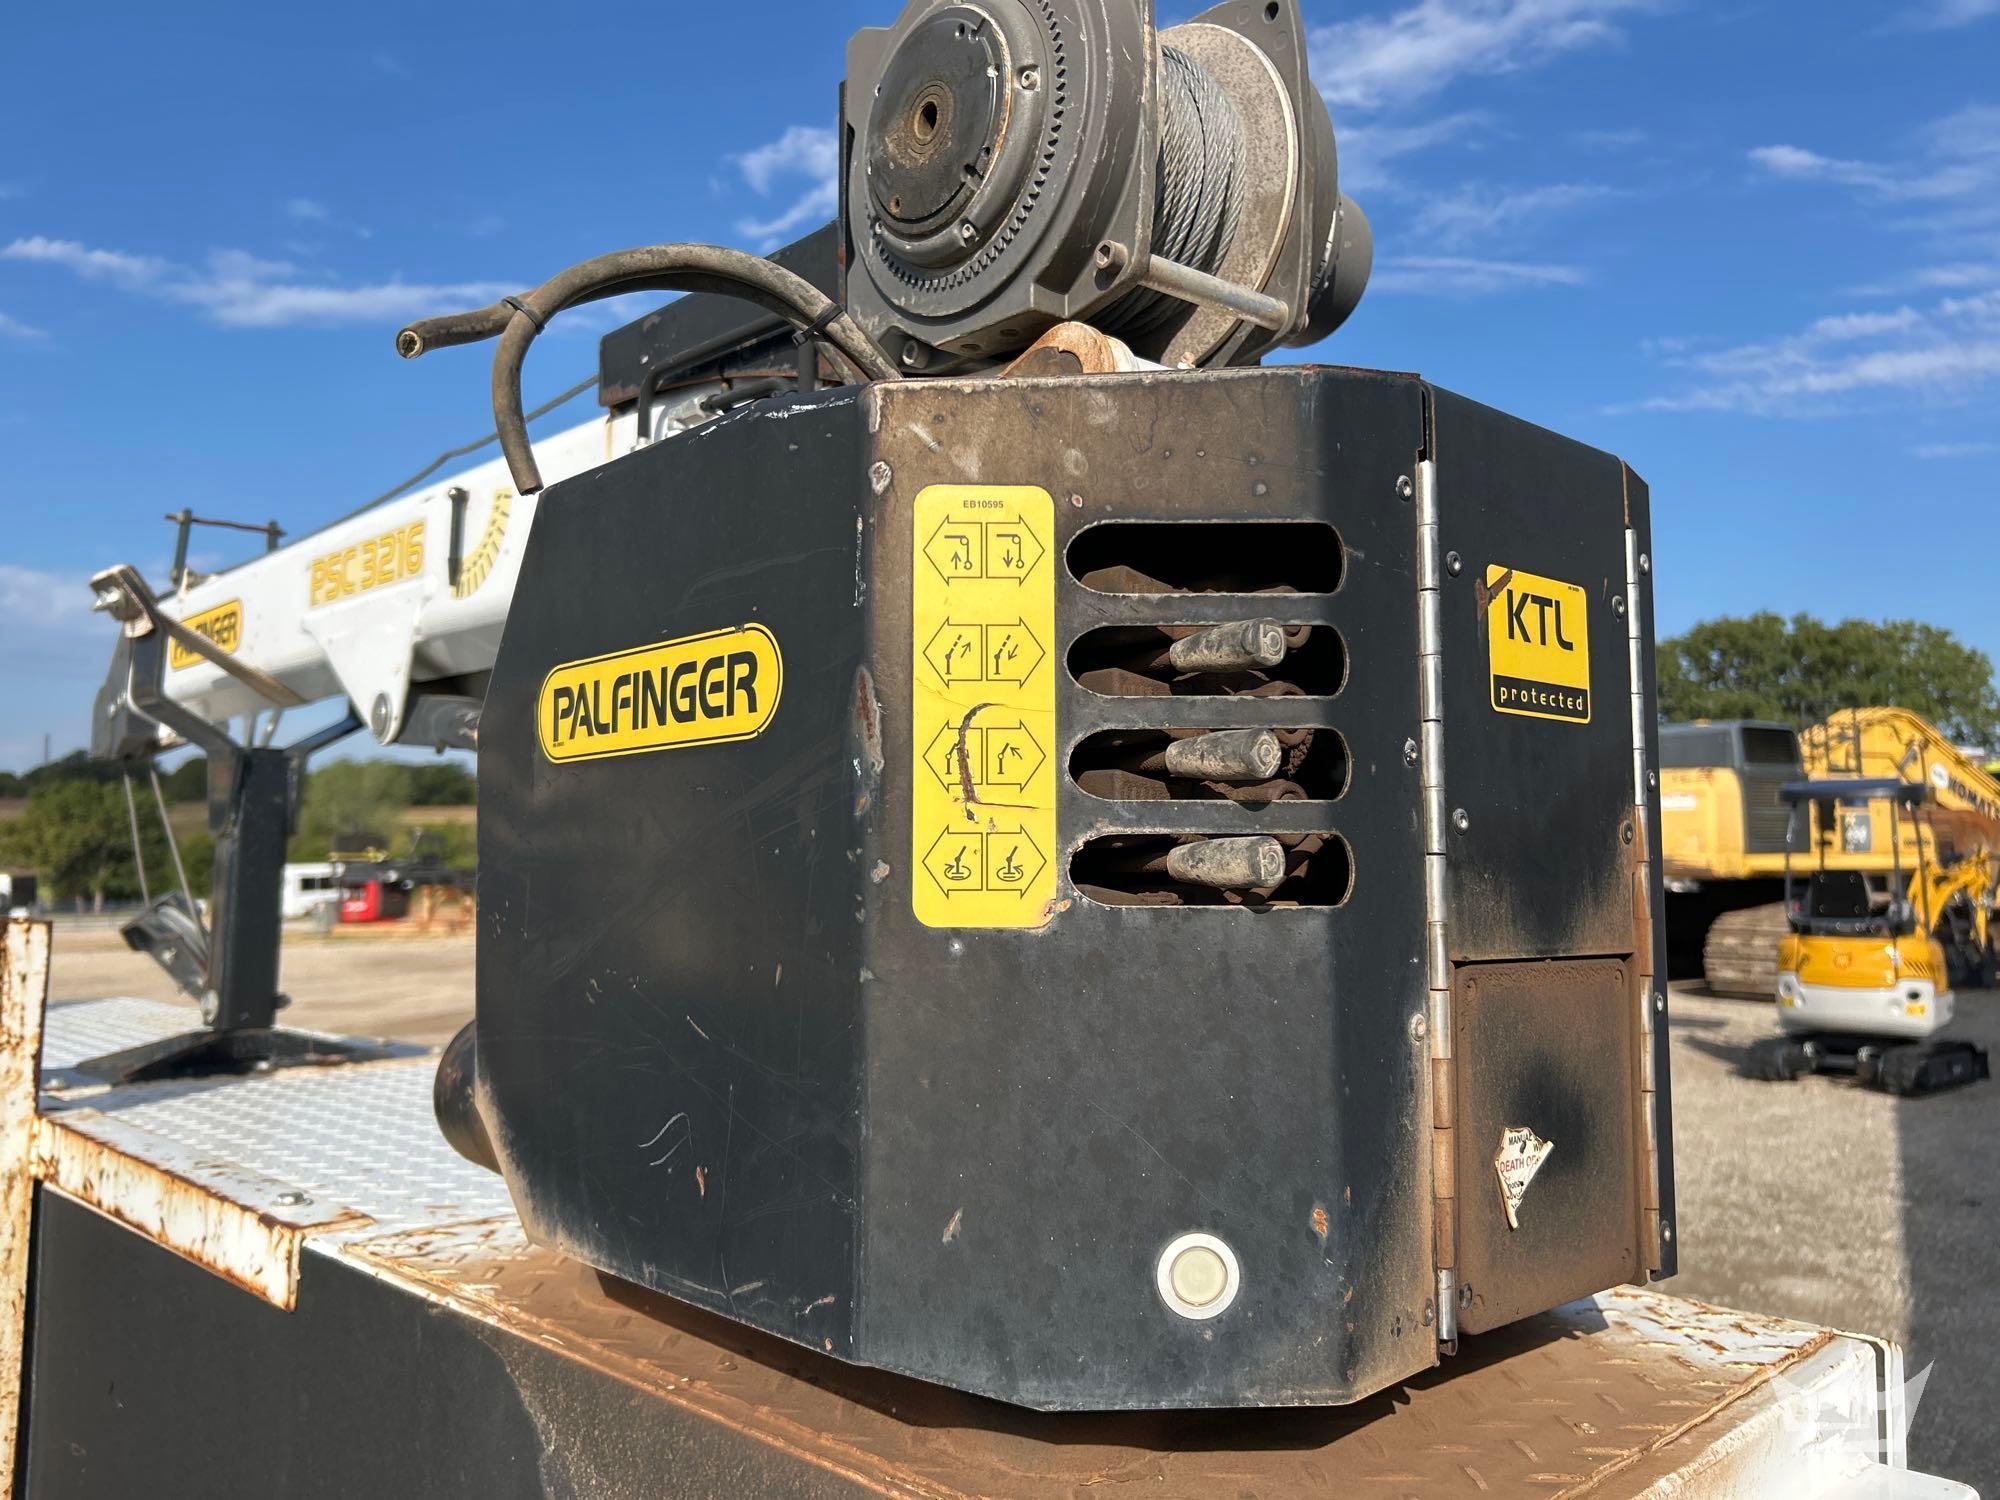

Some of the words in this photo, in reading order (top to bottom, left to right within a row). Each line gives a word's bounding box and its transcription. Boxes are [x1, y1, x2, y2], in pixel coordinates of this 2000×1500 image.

[963, 500, 1004, 509] EB10595
[310, 545, 358, 608] PSC
[361, 521, 425, 591] 3216
[1506, 588, 1574, 651] KTL
[553, 651, 758, 742] PALFINGER
[1500, 686, 1583, 710] protected
[1500, 1159, 1525, 1173] DEATH
